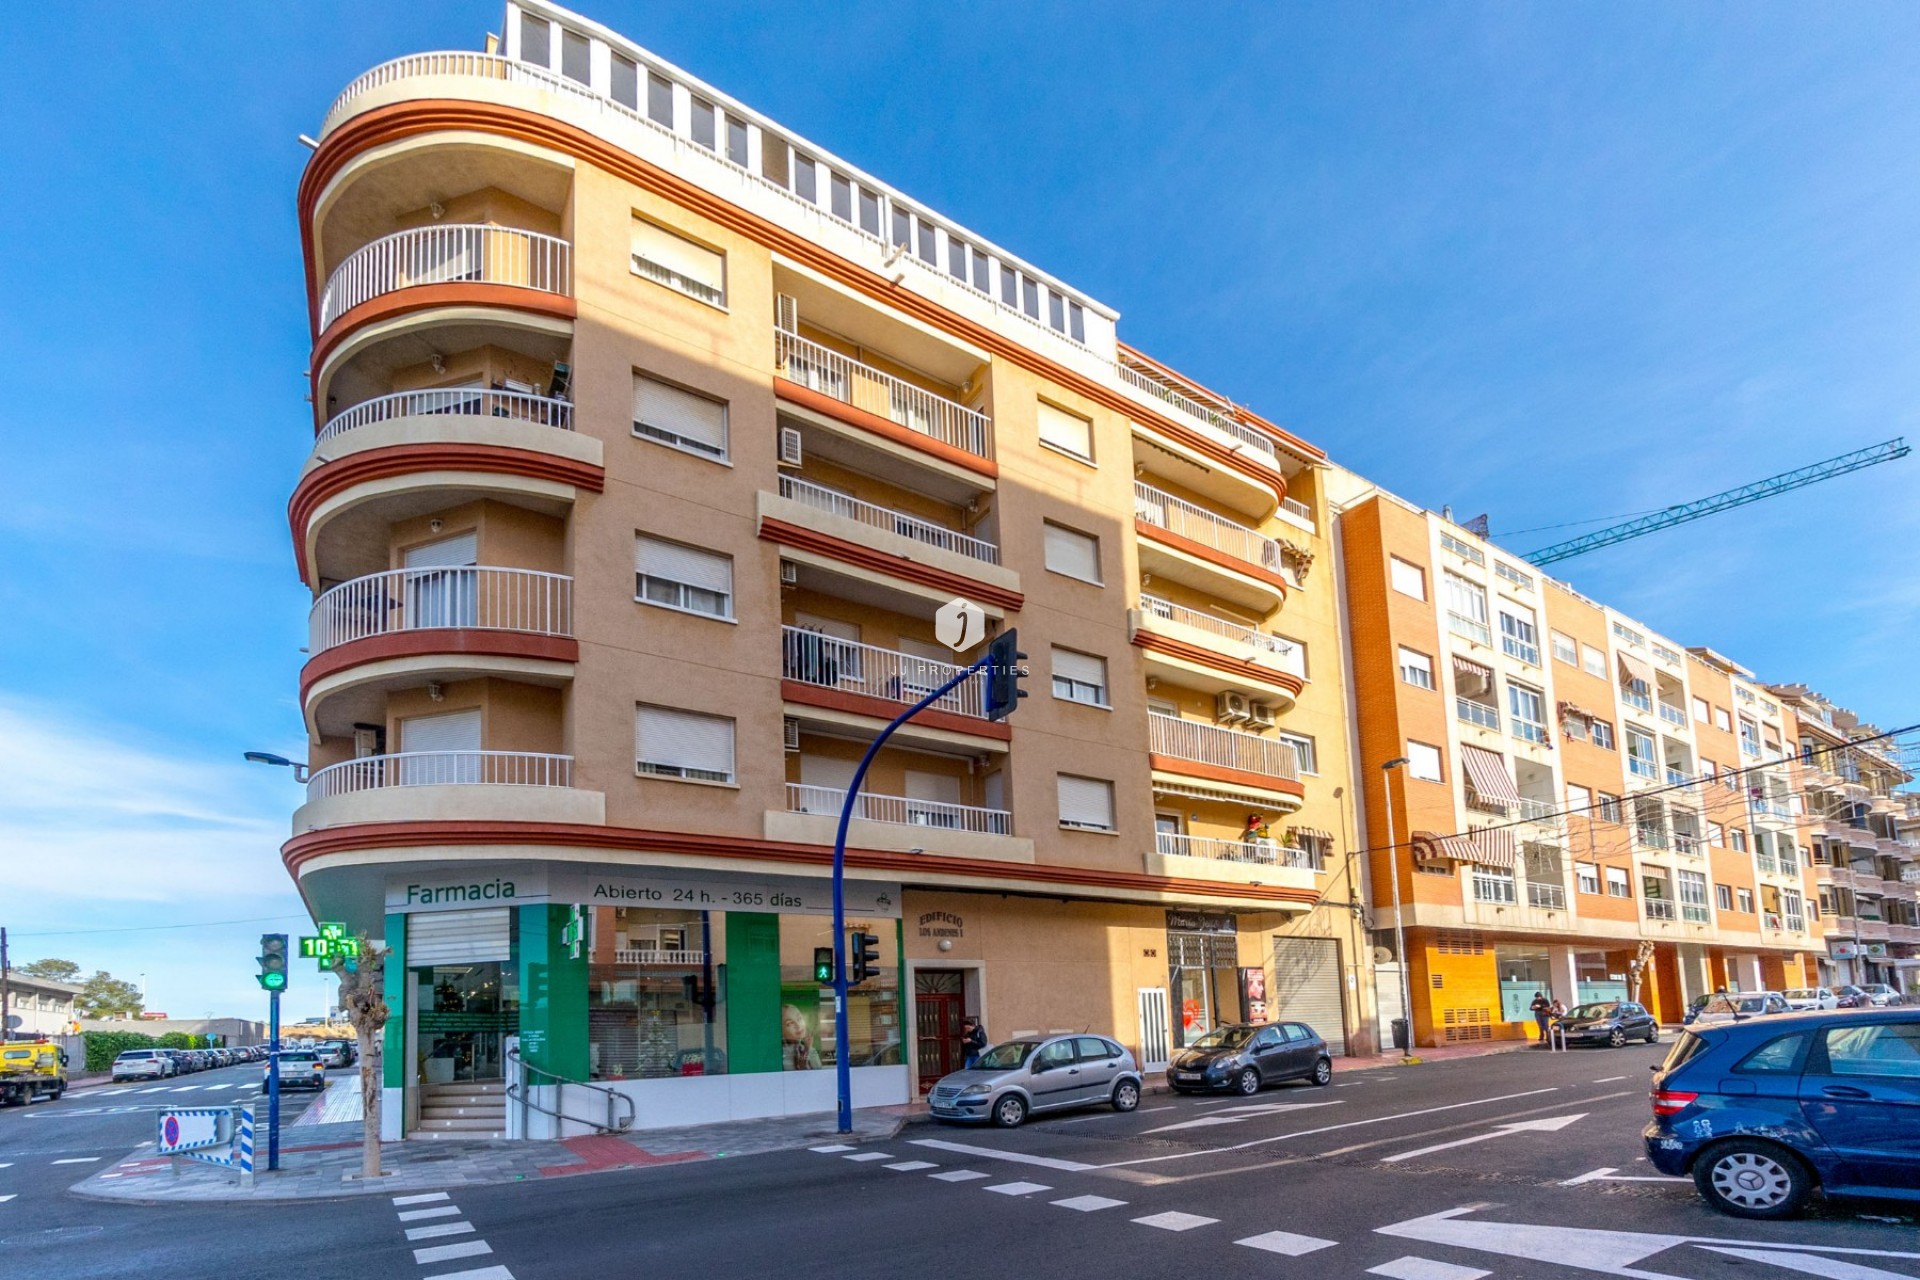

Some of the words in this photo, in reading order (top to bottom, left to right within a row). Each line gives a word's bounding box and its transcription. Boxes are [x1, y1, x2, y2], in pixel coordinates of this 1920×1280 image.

[407, 878, 516, 905] Farmacia
[593, 884, 663, 901] Abierto
[673, 888, 695, 902] 24
[701, 889, 716, 904] h.
[732, 892, 763, 906] 365
[770, 892, 802, 908] días
[919, 911, 964, 928] EDIFICIO
[919, 927, 932, 937] LOS
